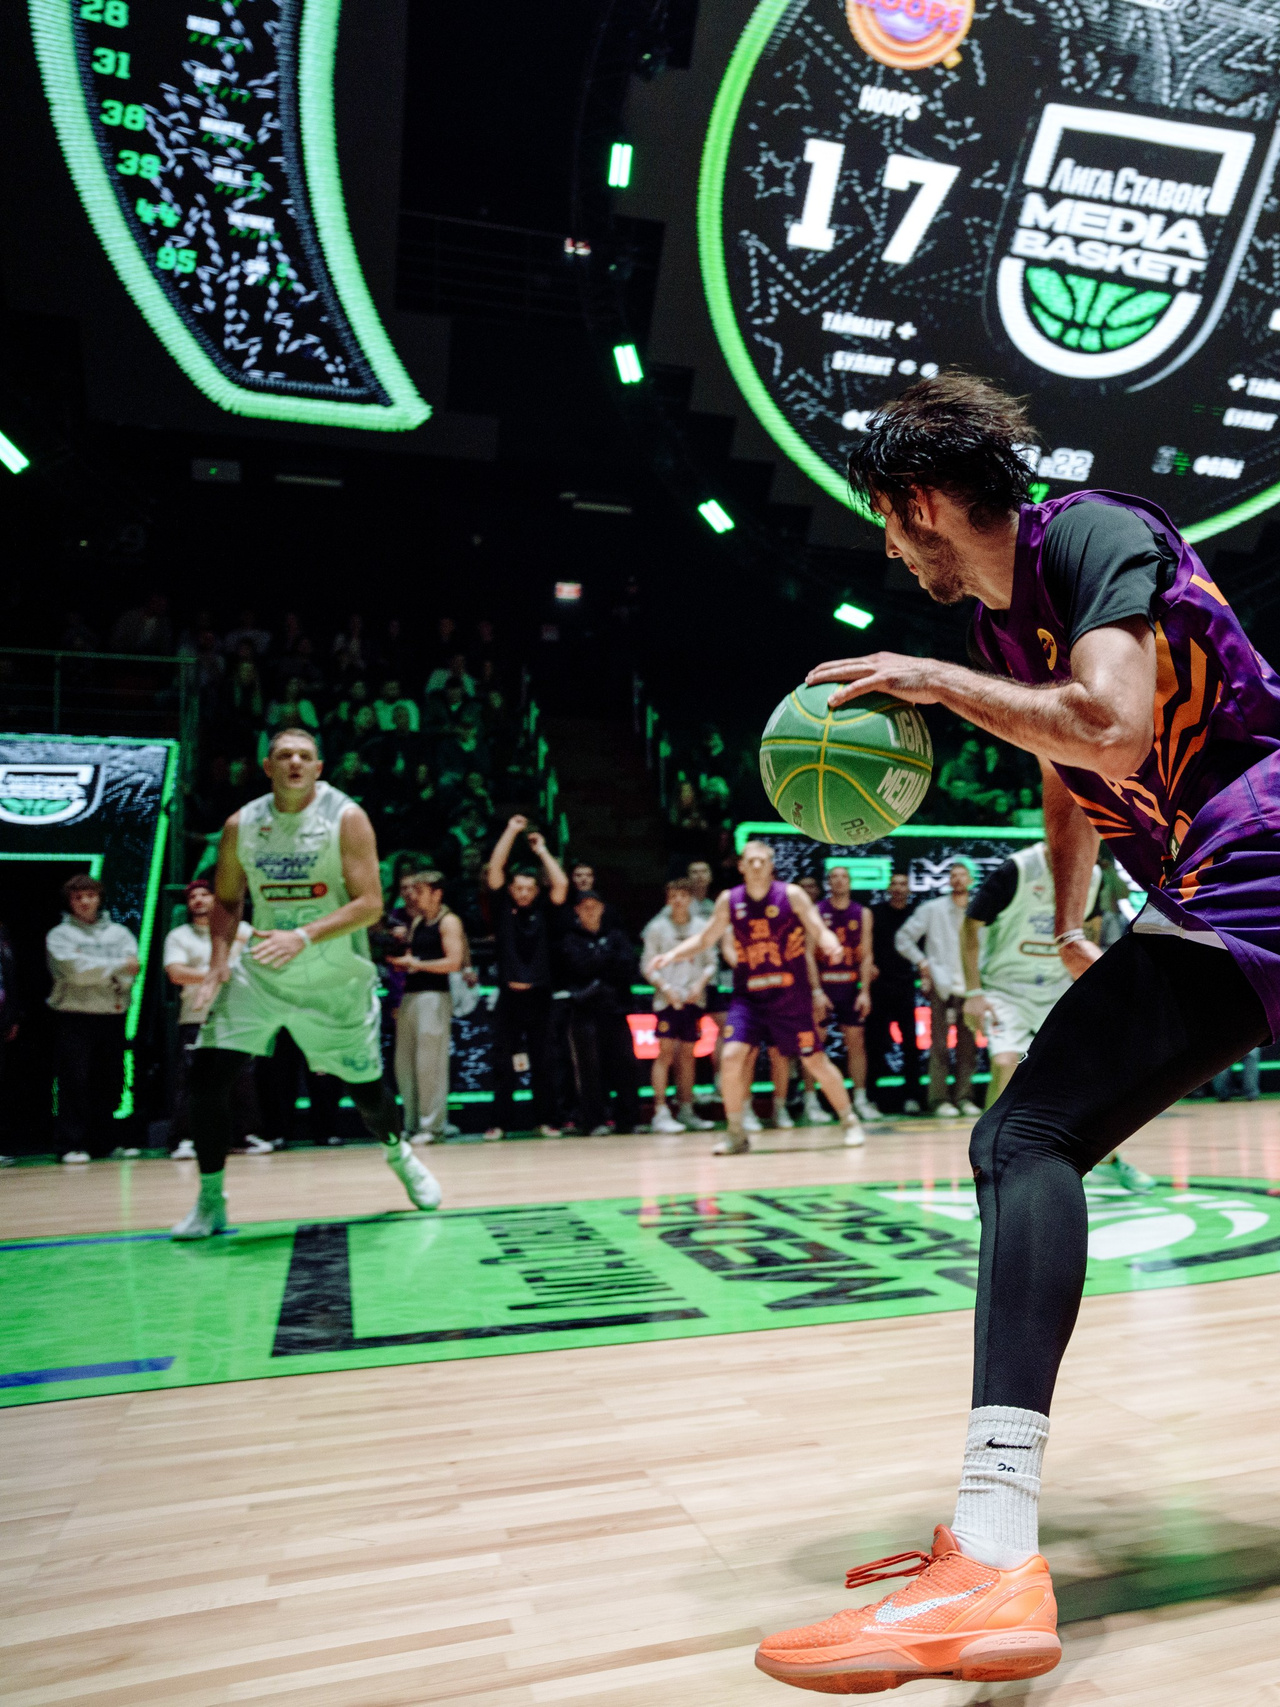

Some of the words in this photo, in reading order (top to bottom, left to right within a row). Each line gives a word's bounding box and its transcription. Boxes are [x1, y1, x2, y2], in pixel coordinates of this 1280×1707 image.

[91, 47, 131, 79] 31
[100, 100, 147, 131] 38
[859, 85, 923, 121] HOOPS
[1019, 192, 1210, 259] MEDIA
[156, 246, 197, 274] 95
[1010, 228, 1207, 286] BASKET
[618, 1196, 940, 1312] MEDIA
